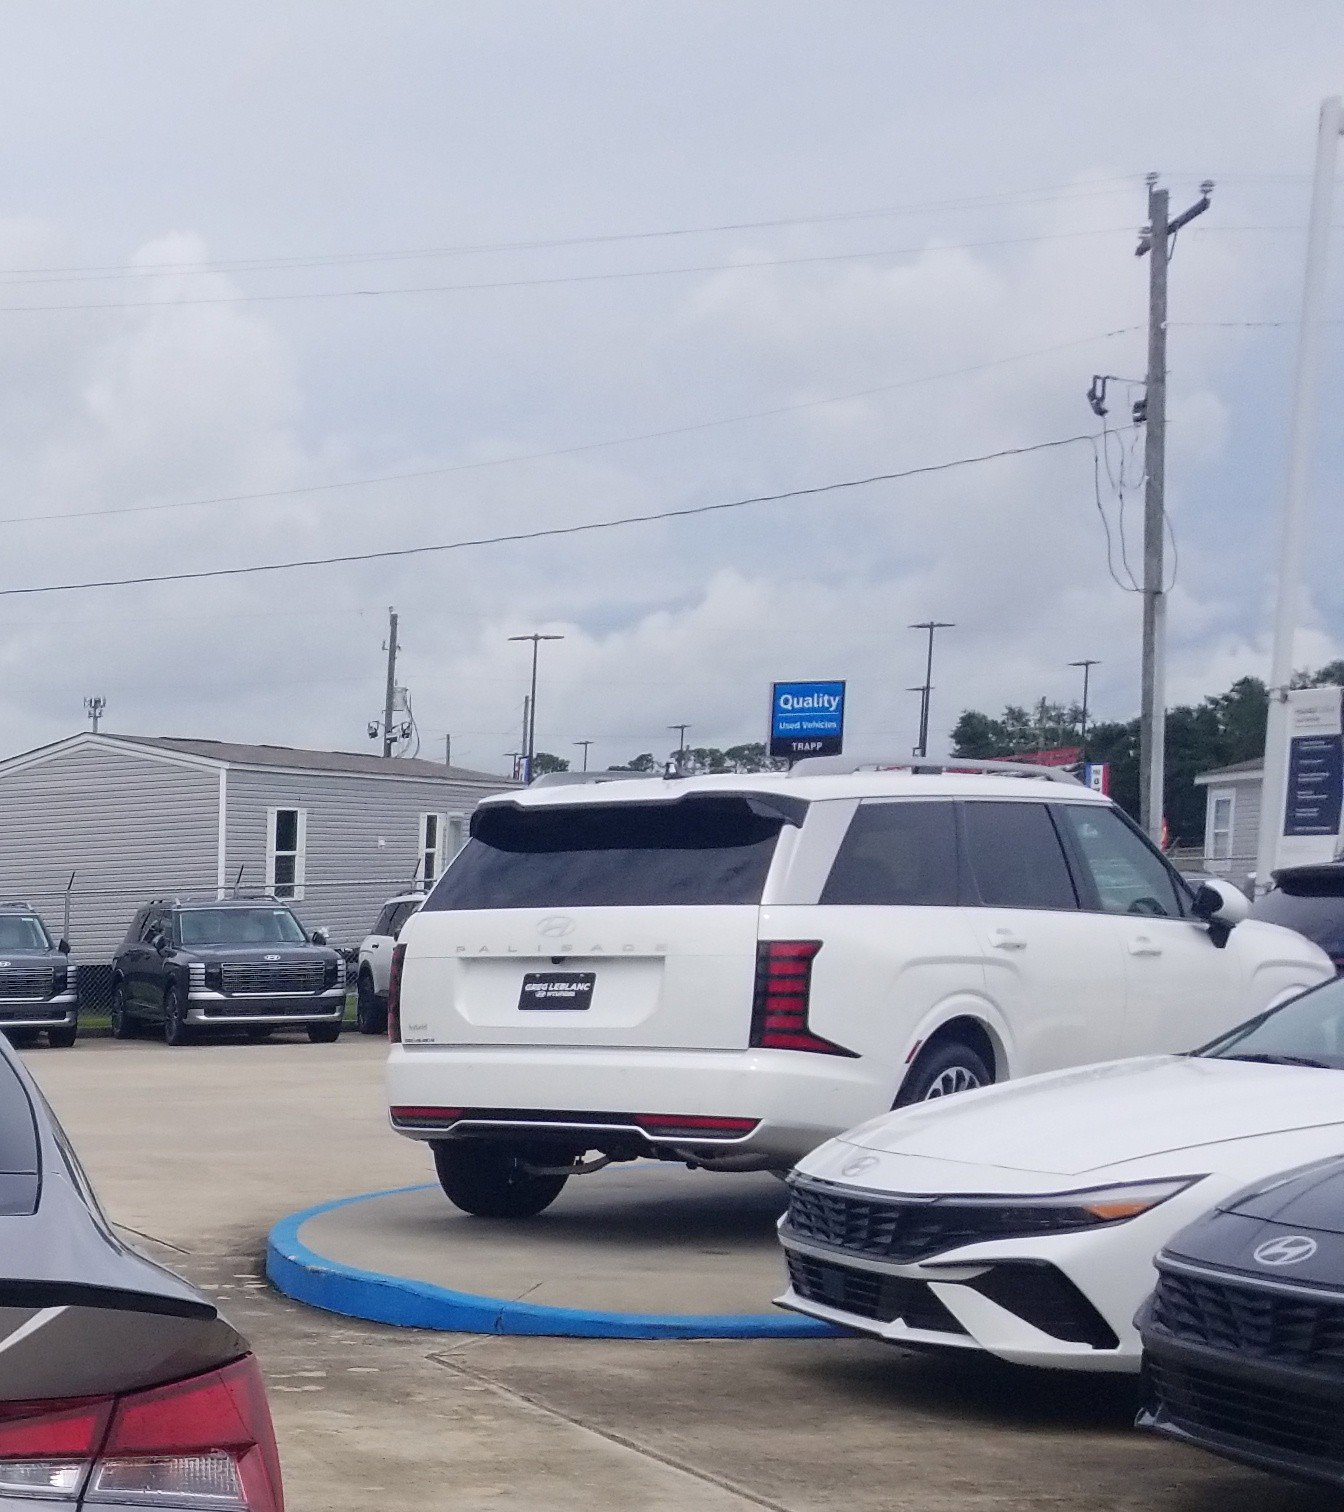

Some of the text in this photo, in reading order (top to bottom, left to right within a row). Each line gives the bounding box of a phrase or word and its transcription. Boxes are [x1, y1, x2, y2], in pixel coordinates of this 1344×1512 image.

[779, 693, 840, 711] Quality
[779, 720, 837, 730] Used Vehicles
[792, 742, 823, 751] TRAPP
[456, 944, 667, 953] PALISADE
[525, 982, 591, 991] GREG LEBLANC
